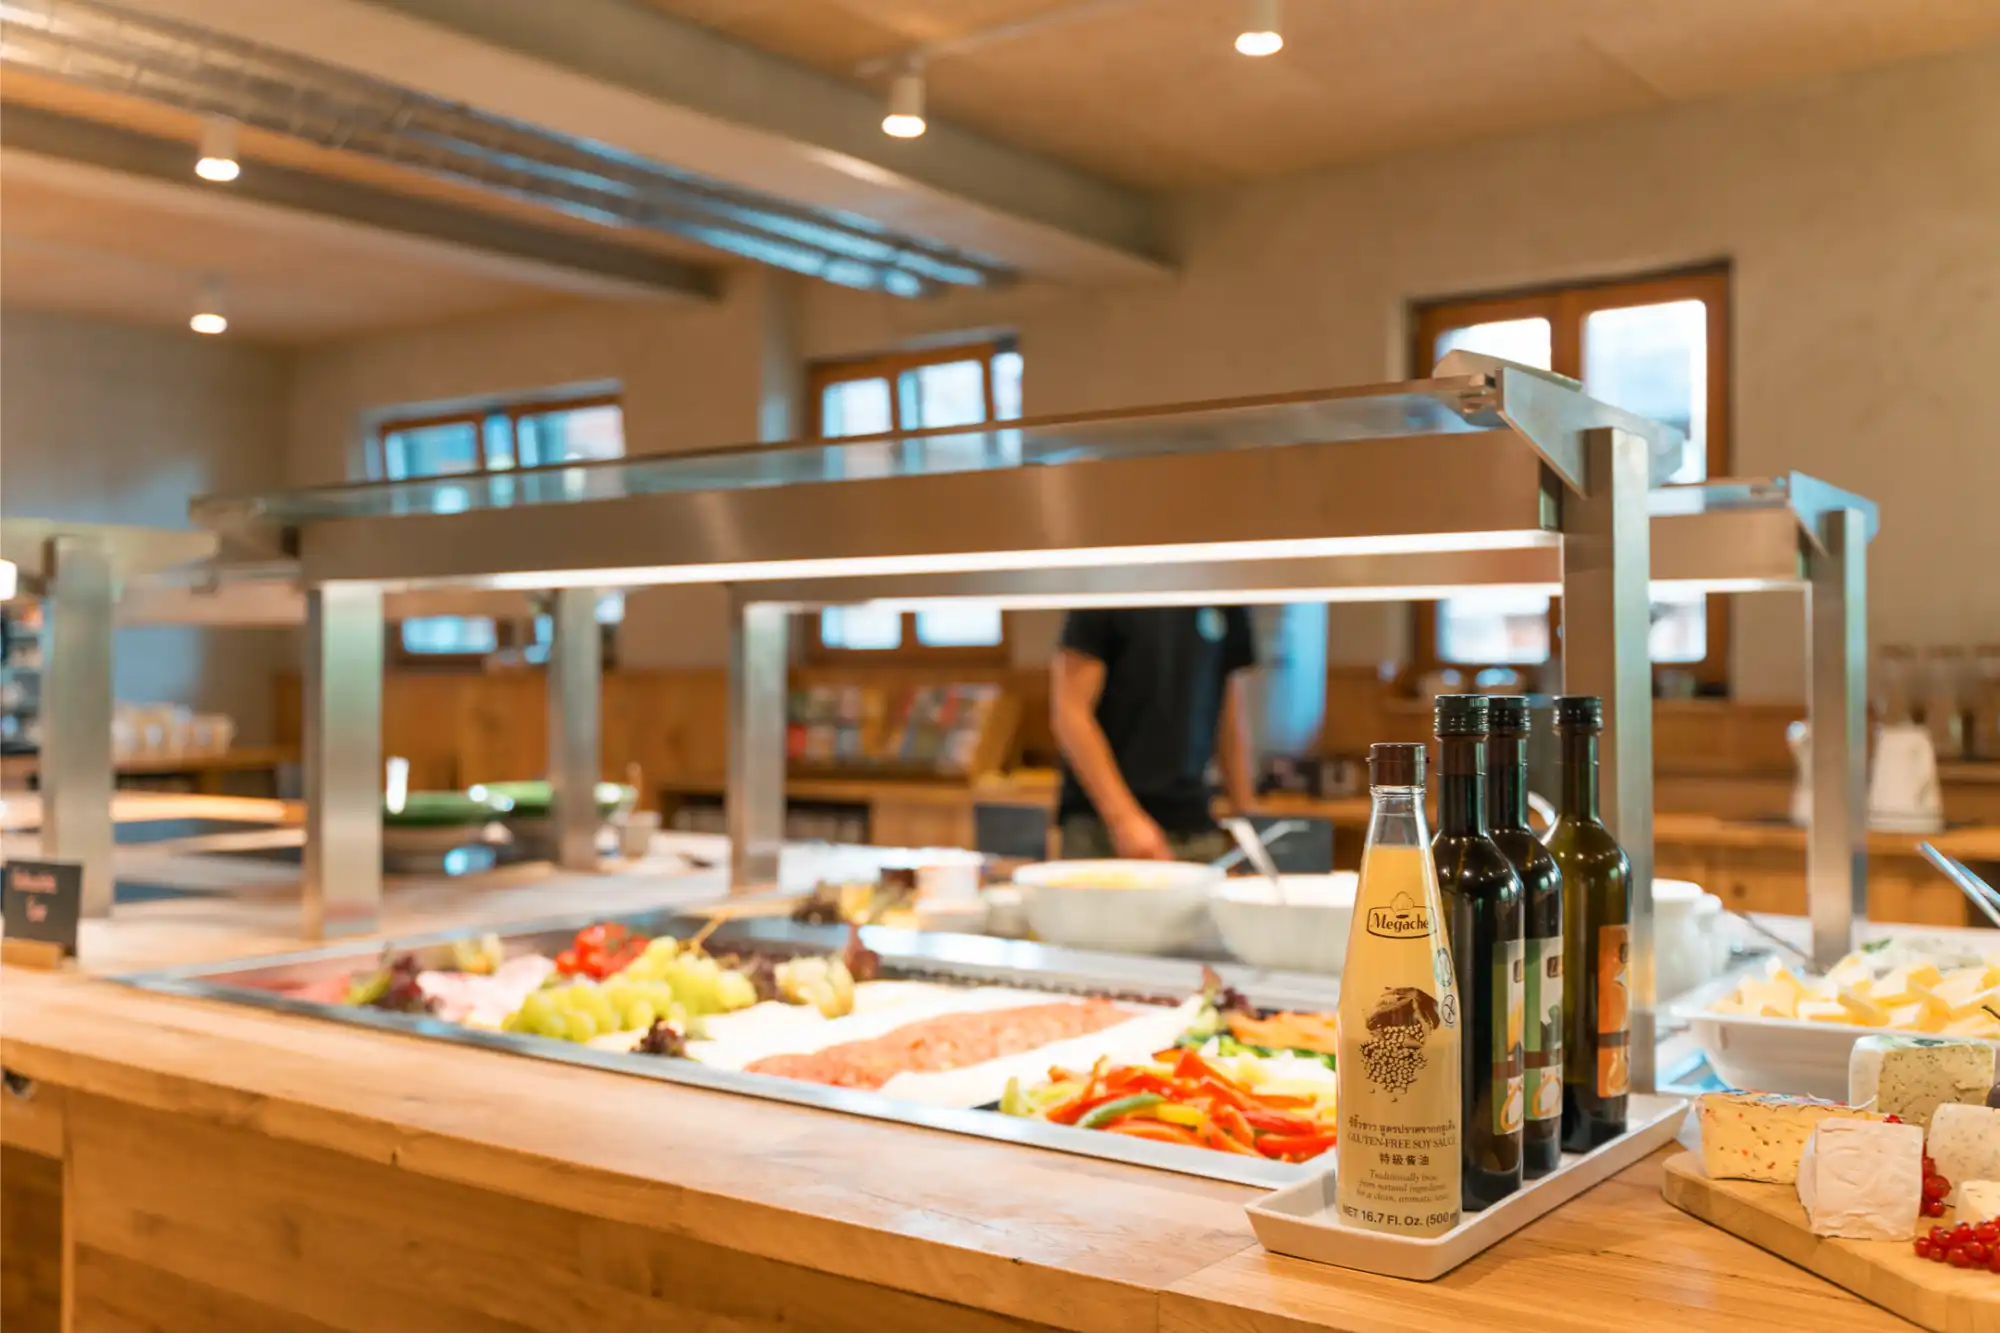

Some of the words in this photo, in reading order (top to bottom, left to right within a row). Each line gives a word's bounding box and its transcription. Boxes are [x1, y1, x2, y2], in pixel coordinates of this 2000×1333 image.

[1369, 912, 1431, 933] Megache
[1347, 1132, 1411, 1149] GLUTEN-FREE
[1412, 1139, 1431, 1150] SOY
[1357, 1178, 1375, 1189] from
[1378, 1183, 1407, 1193] natural
[1342, 1203, 1359, 1217] NET
[1361, 1210, 1385, 1224] 16.7
[1404, 1216, 1423, 1226] Oz.
